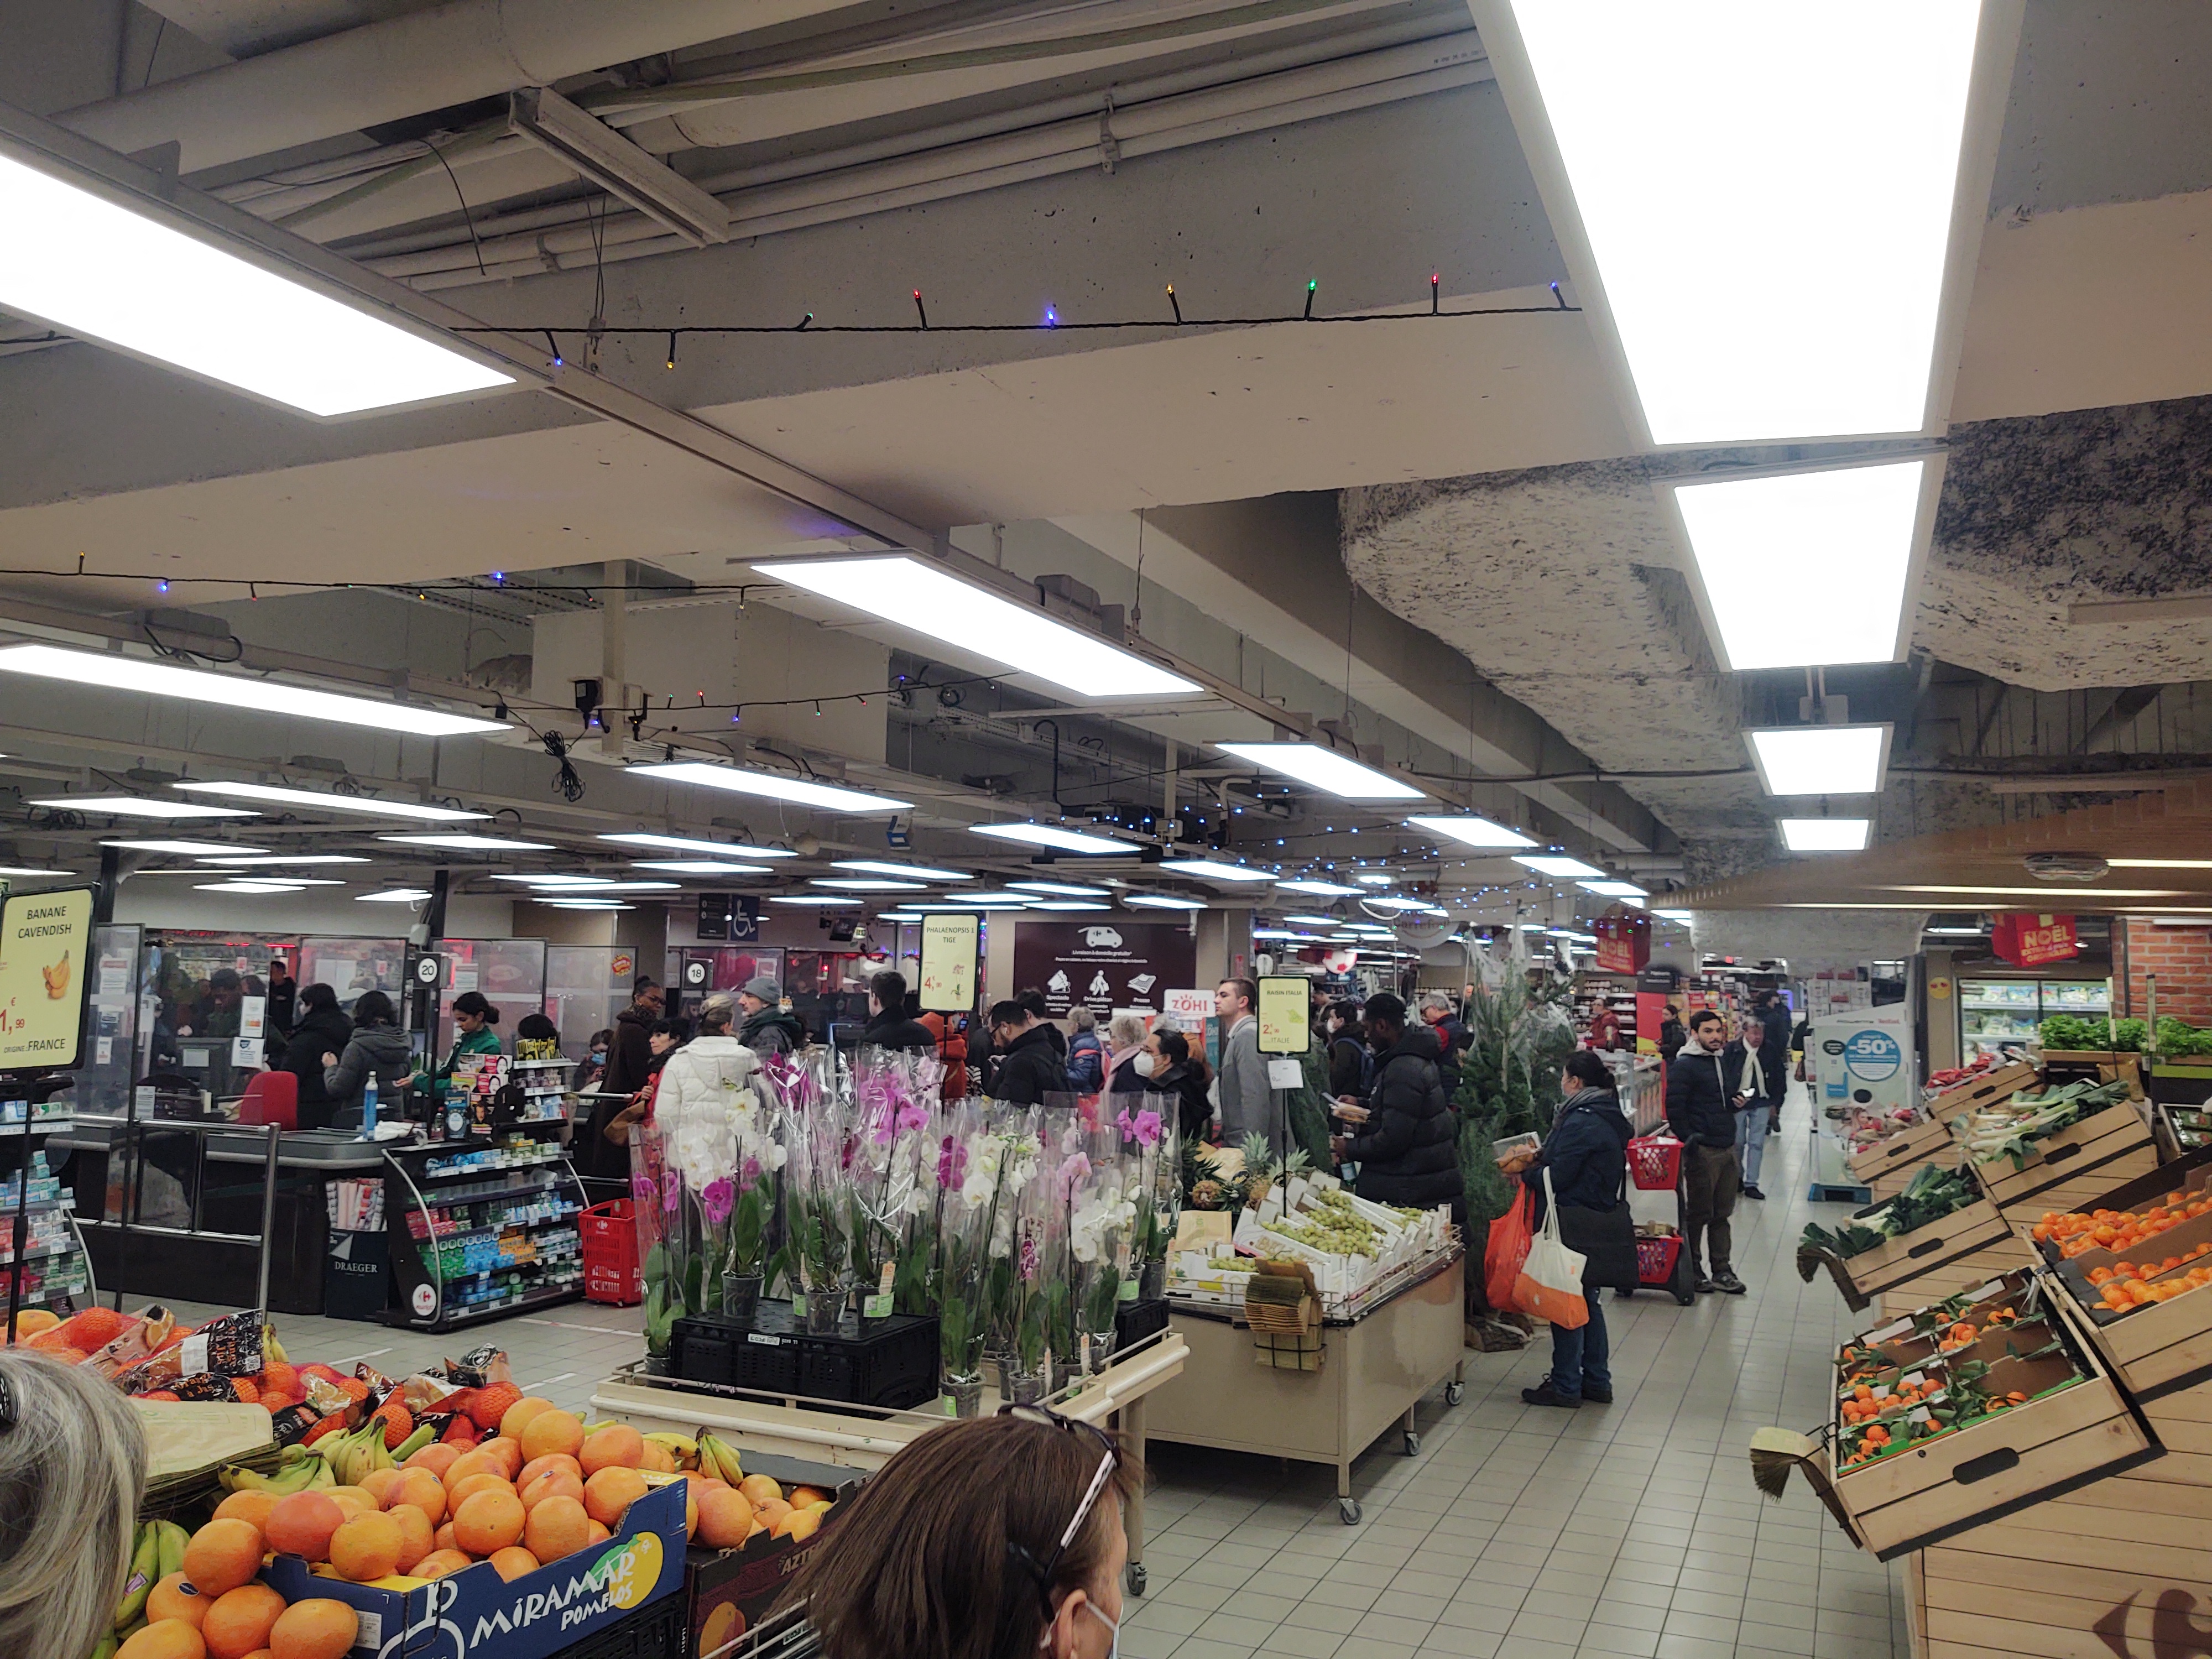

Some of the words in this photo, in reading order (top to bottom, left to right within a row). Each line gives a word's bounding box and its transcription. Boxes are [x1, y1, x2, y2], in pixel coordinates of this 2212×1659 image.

[27, 906, 67, 920] BANANE
[18, 924, 72, 938] CAVENDISH
[2024, 924, 2072, 948] NOËL
[422, 965, 434, 975] 20
[692, 969, 701, 978] 18
[15, 1018, 25, 1029] 99
[28, 1038, 66, 1051] FRANCE
[334, 1261, 378, 1273] DRAEGER
[196, 1384, 215, 1395] Jus
[561, 1580, 634, 1631] POMELOS
